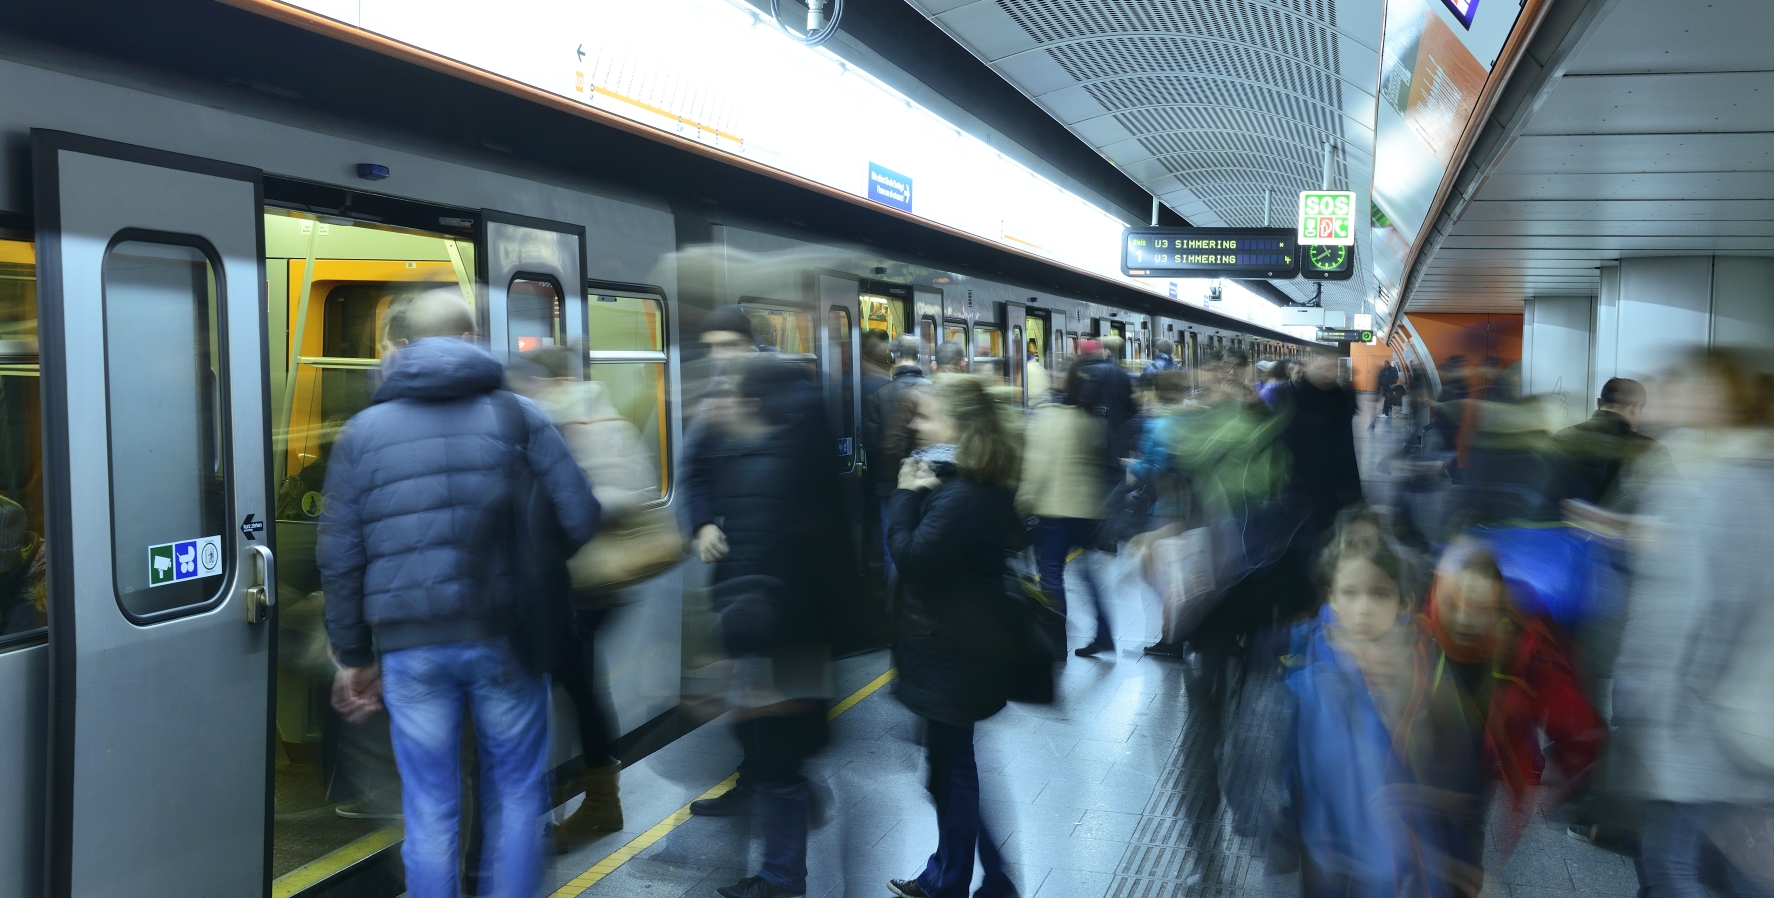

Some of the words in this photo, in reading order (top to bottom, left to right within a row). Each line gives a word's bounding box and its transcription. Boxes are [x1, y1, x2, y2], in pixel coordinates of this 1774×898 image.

[1305, 196, 1349, 215] SOS
[1132, 239, 1147, 247] Gleis
[1154, 240, 1169, 249] U3
[1174, 240, 1237, 249] SIMMERING
[1135, 250, 1143, 263] 1
[1154, 254, 1168, 264] U3
[1174, 254, 1236, 264] SIMMERING
